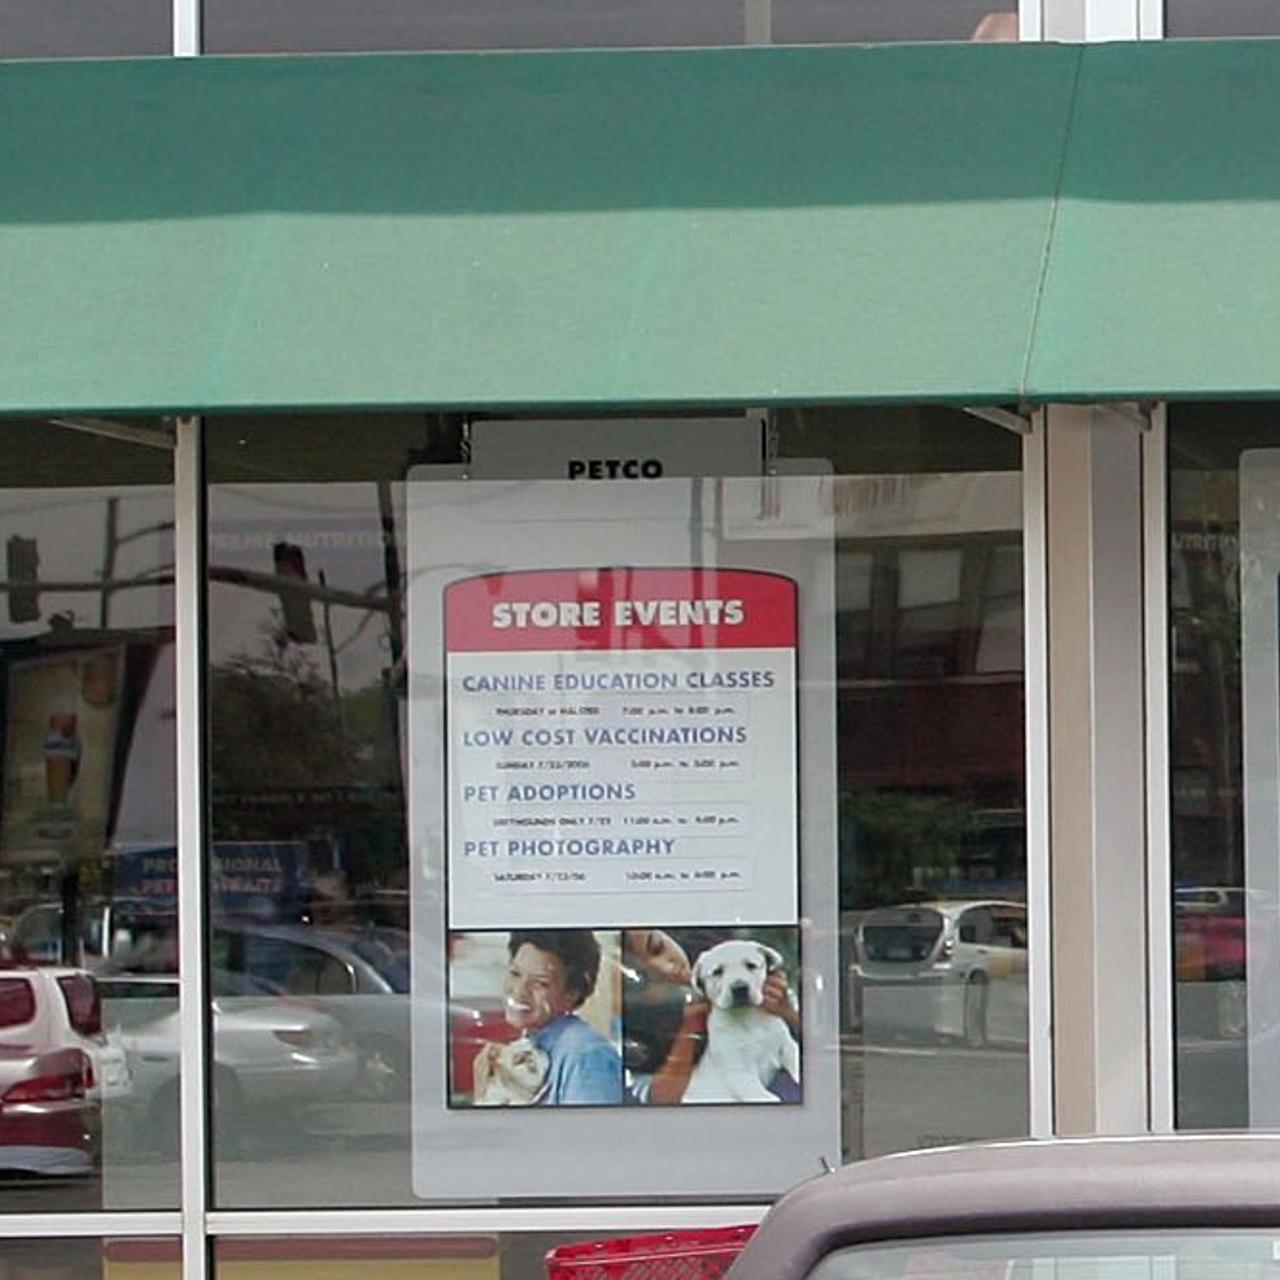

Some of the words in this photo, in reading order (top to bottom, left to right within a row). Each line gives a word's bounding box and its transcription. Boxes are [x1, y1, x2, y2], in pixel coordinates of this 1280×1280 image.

[568, 460, 663, 480] PETCO
[492, 600, 600, 629] STORE
[614, 599, 745, 627] EVENTS
[463, 674, 546, 692] CANINE
[553, 672, 678, 690] EDUCATION
[686, 671, 775, 689] CLASSES
[463, 730, 514, 747] LOW
[522, 728, 577, 745] COST
[584, 726, 748, 745] VACCINATIONS
[464, 786, 499, 803] PET
[507, 783, 637, 802] ADOPTIONS
[464, 841, 499, 858] PET
[508, 838, 675, 857] PHOTOGRAPHY
